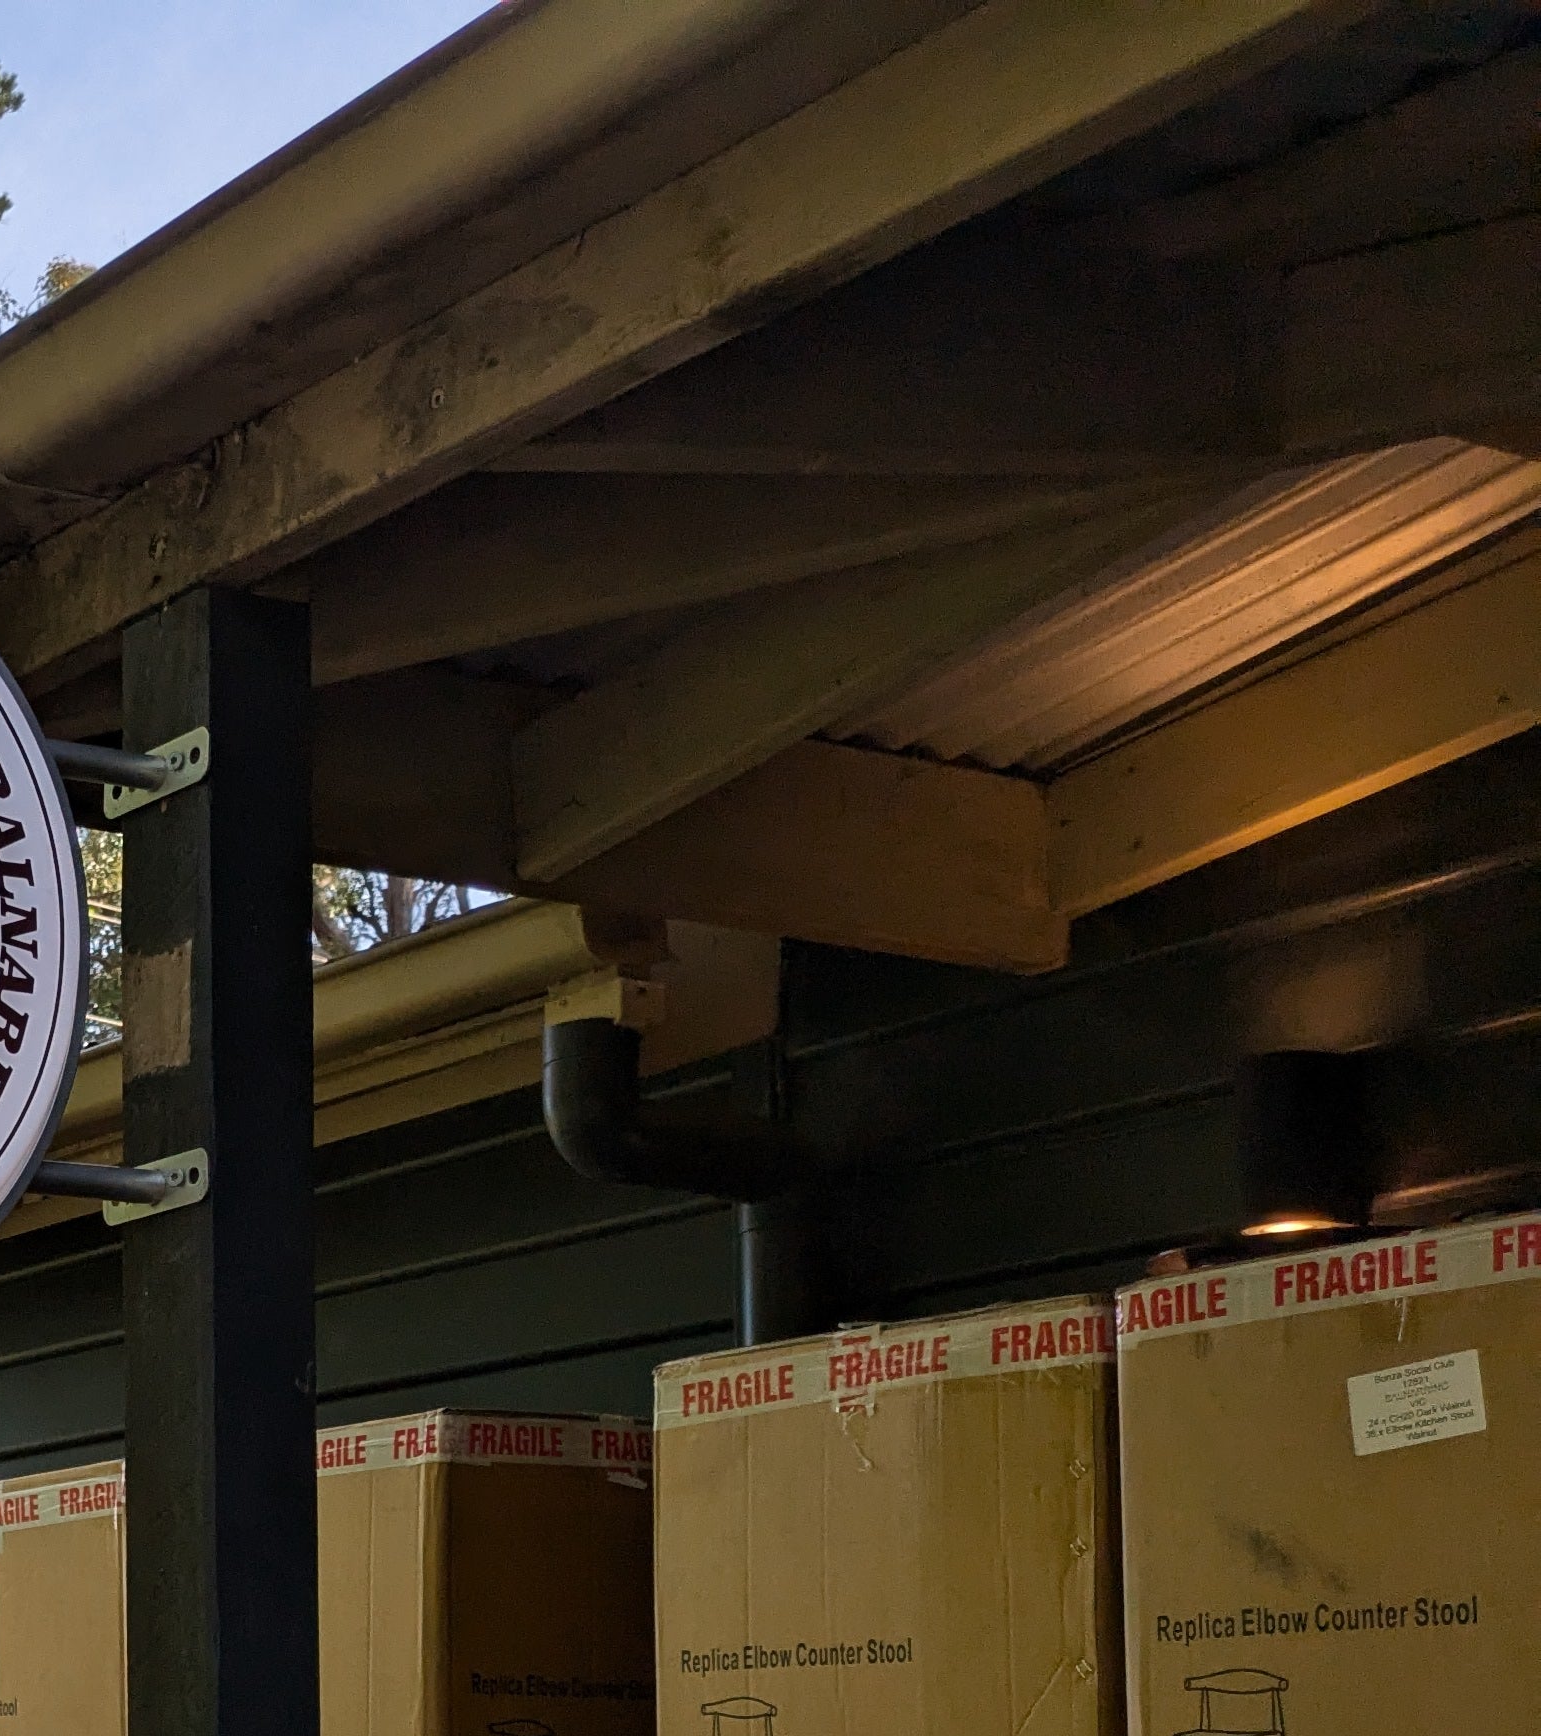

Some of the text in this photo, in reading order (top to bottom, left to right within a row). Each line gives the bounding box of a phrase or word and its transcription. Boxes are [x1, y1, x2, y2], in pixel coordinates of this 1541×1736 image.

[1118, 1278, 1227, 1335] AGILE
[1274, 1240, 1438, 1307] FRAGILE
[682, 1364, 794, 1418] FRAGILE
[828, 1335, 950, 1391] FRAGILE
[1404, 1365, 1432, 1377] Social
[468, 1423, 565, 1457] FRAGILE
[1157, 1596, 1478, 1646] Replica Elbow Counter Stool
[681, 1637, 913, 1678] Replica Elbow Counter Stool
